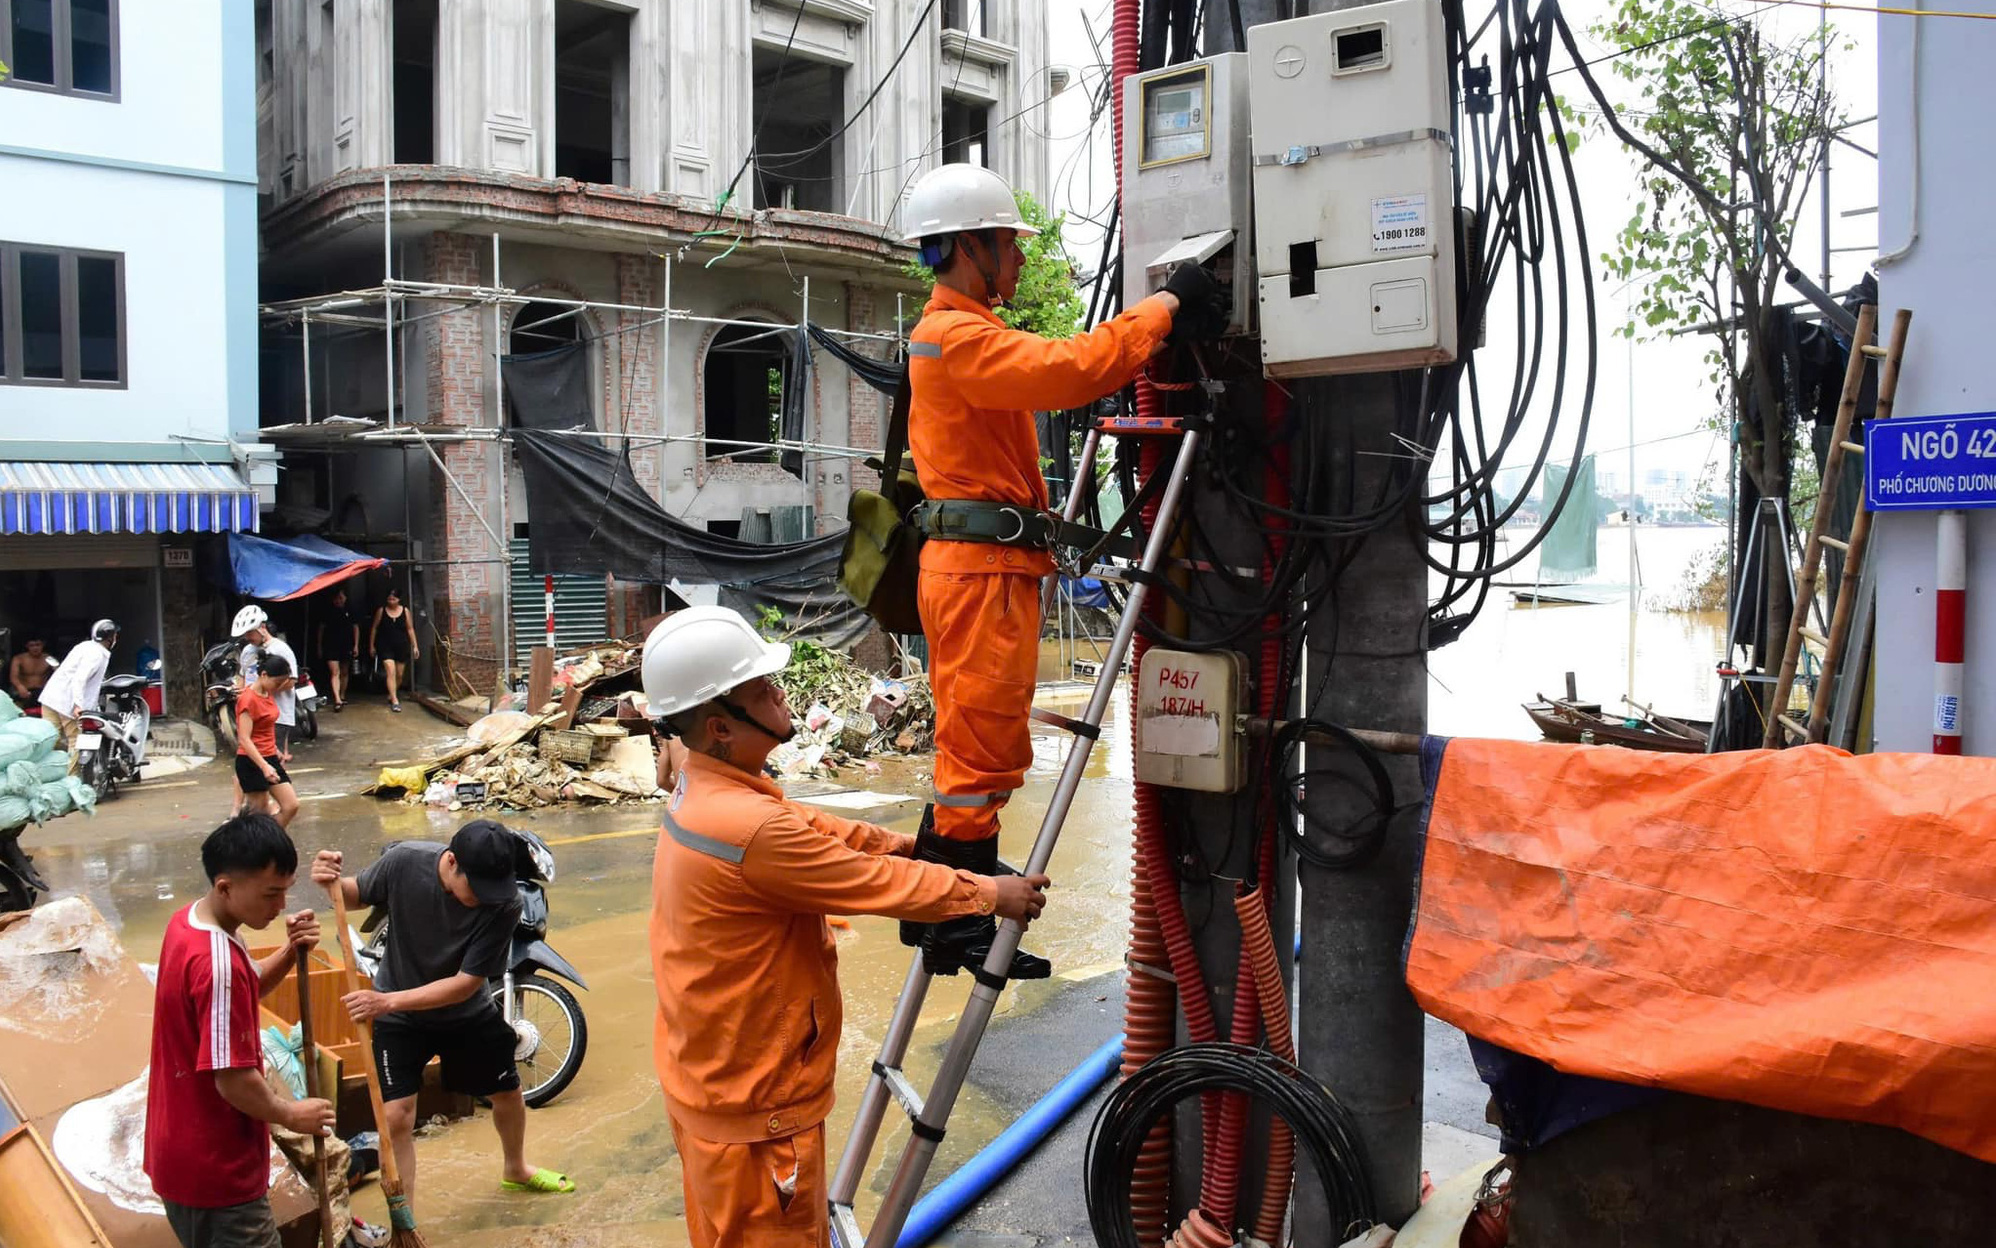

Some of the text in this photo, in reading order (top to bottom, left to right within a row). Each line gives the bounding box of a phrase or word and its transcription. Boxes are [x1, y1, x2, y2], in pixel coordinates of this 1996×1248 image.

[1381, 227, 1425, 240] 1900 1288
[1902, 423, 1996, 460] NGÕ 42
[1879, 471, 1996, 494] PHỐ CHƯƠNG DƯƠN
[1159, 667, 1200, 690] P457
